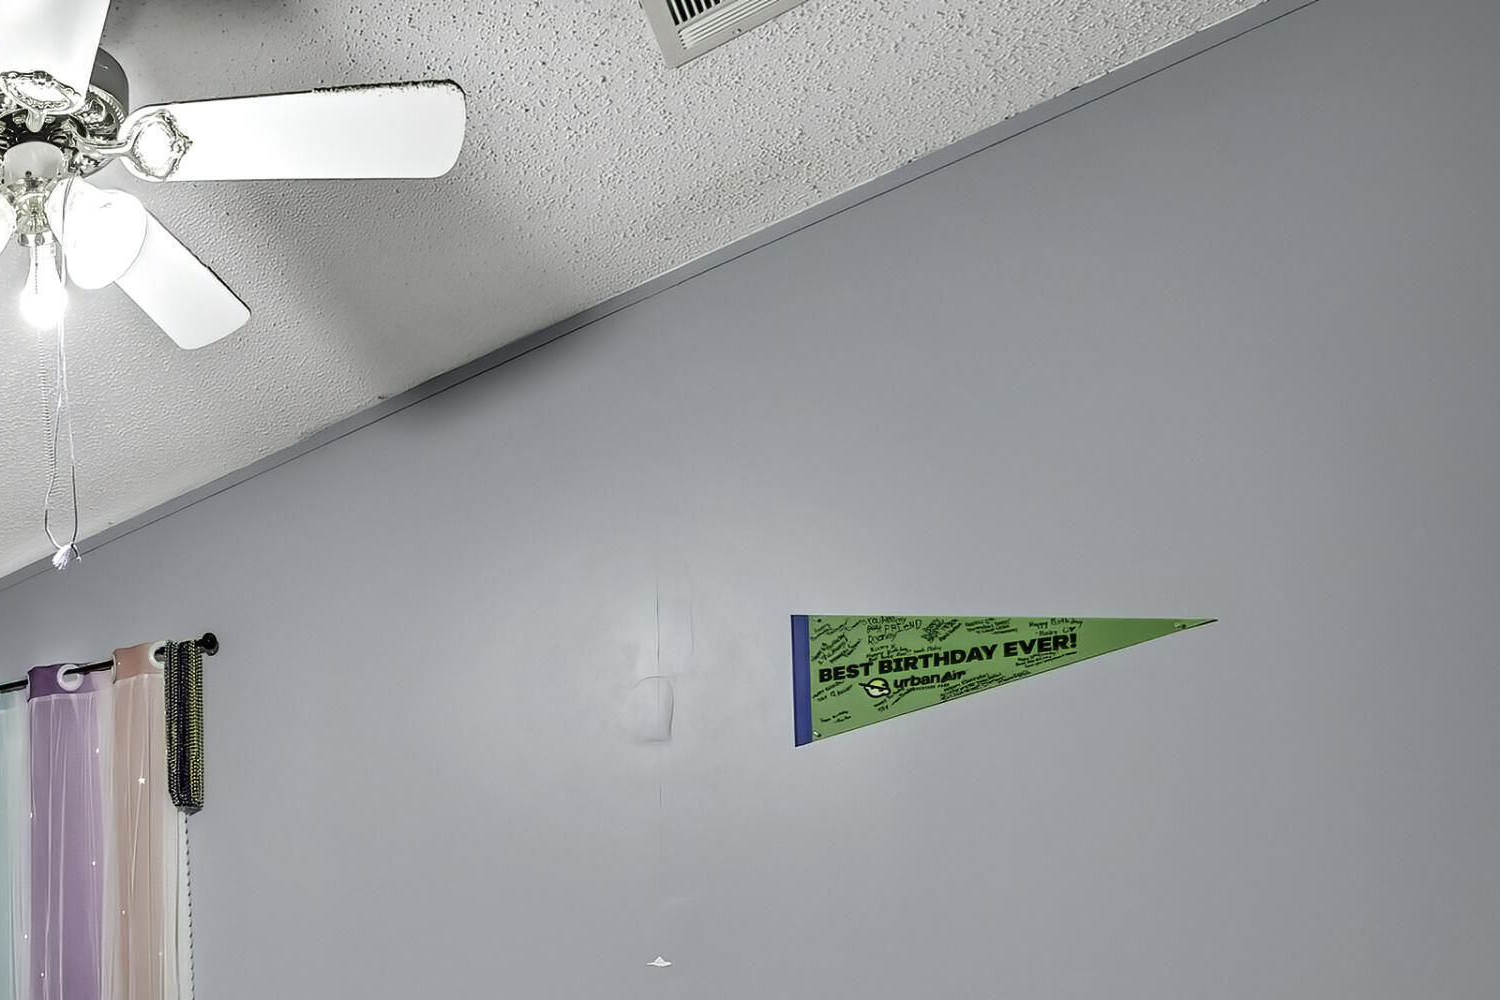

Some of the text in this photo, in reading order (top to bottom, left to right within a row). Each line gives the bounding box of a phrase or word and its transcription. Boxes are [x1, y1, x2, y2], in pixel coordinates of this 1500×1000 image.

[818, 661, 874, 683] BEST
[878, 644, 998, 674] BIRTHDAY
[1003, 632, 1077, 657] EVER!
